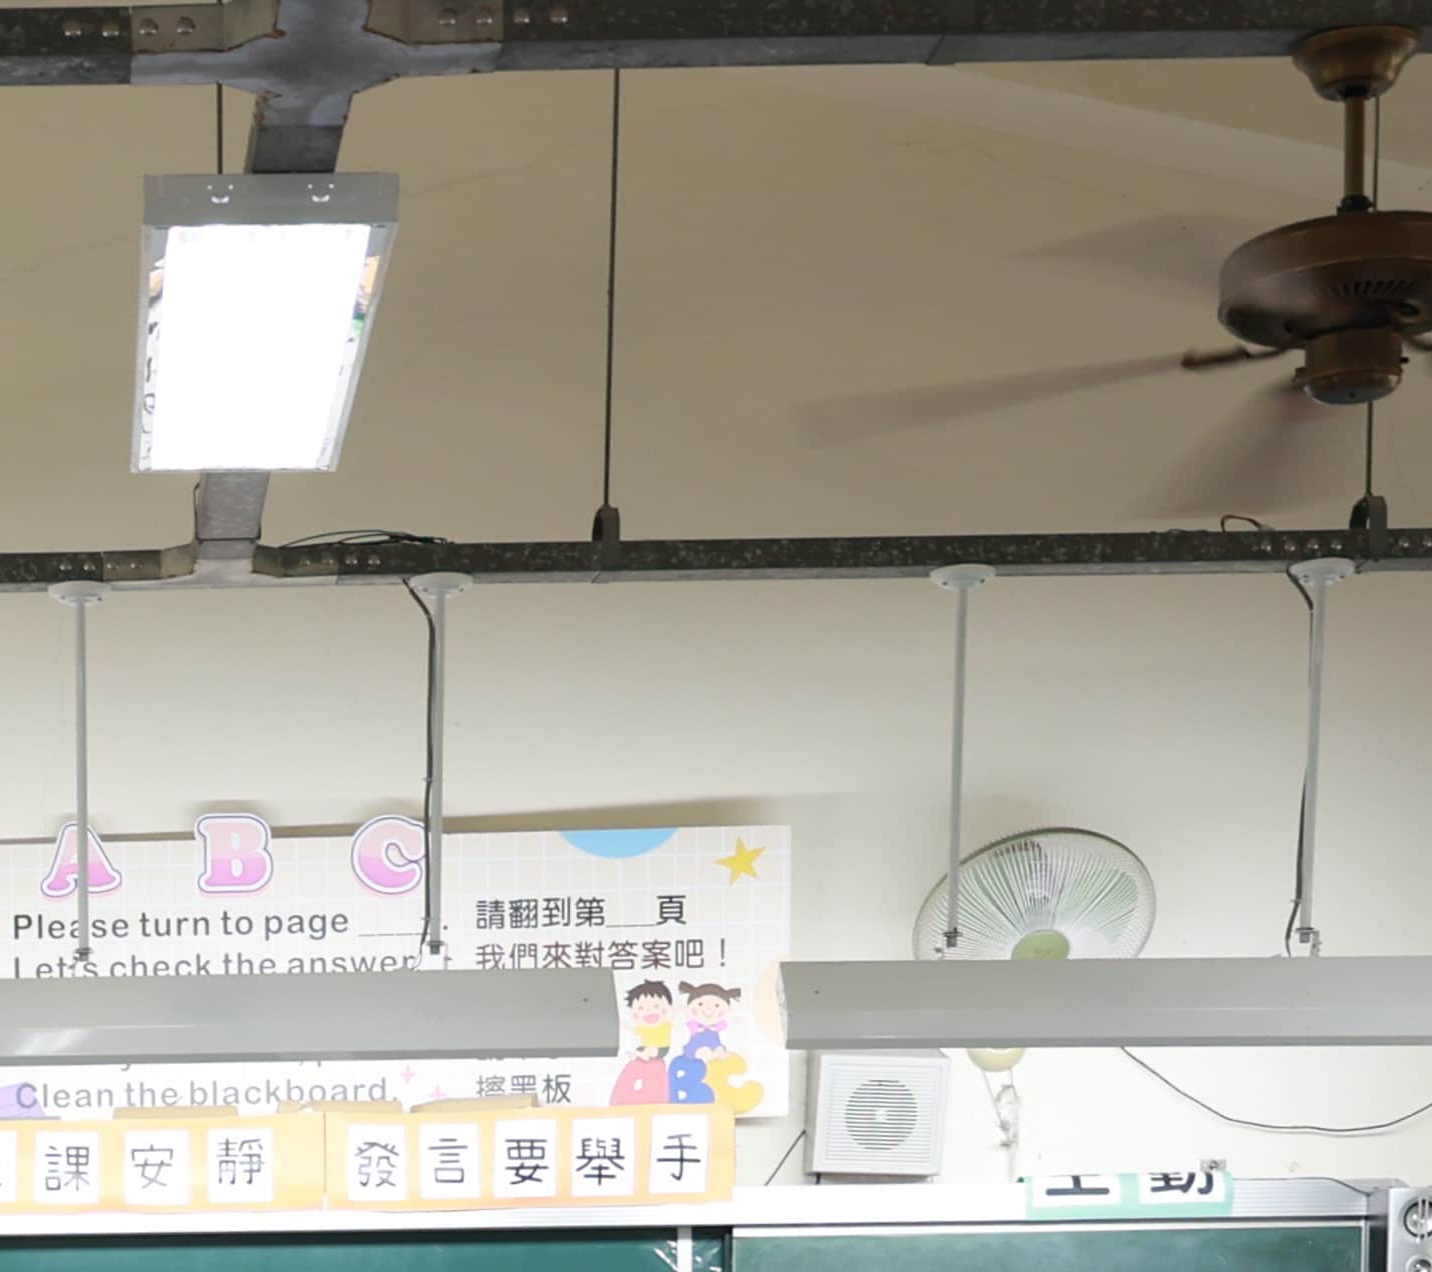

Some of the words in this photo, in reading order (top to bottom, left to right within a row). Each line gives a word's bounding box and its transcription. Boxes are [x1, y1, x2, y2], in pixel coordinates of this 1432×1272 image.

[194, 813, 274, 896] B
[351, 814, 428, 896] C
[13, 913, 129, 940] Please
[139, 912, 211, 938] turn
[221, 911, 254, 936] to
[264, 912, 350, 942] page
[223, 953, 282, 976] the
[15, 1082, 115, 1110] Clean
[125, 1080, 183, 1108] the
[190, 1077, 399, 1107] blackboard.
[354, 1132, 701, 1188] 發言要舉手
